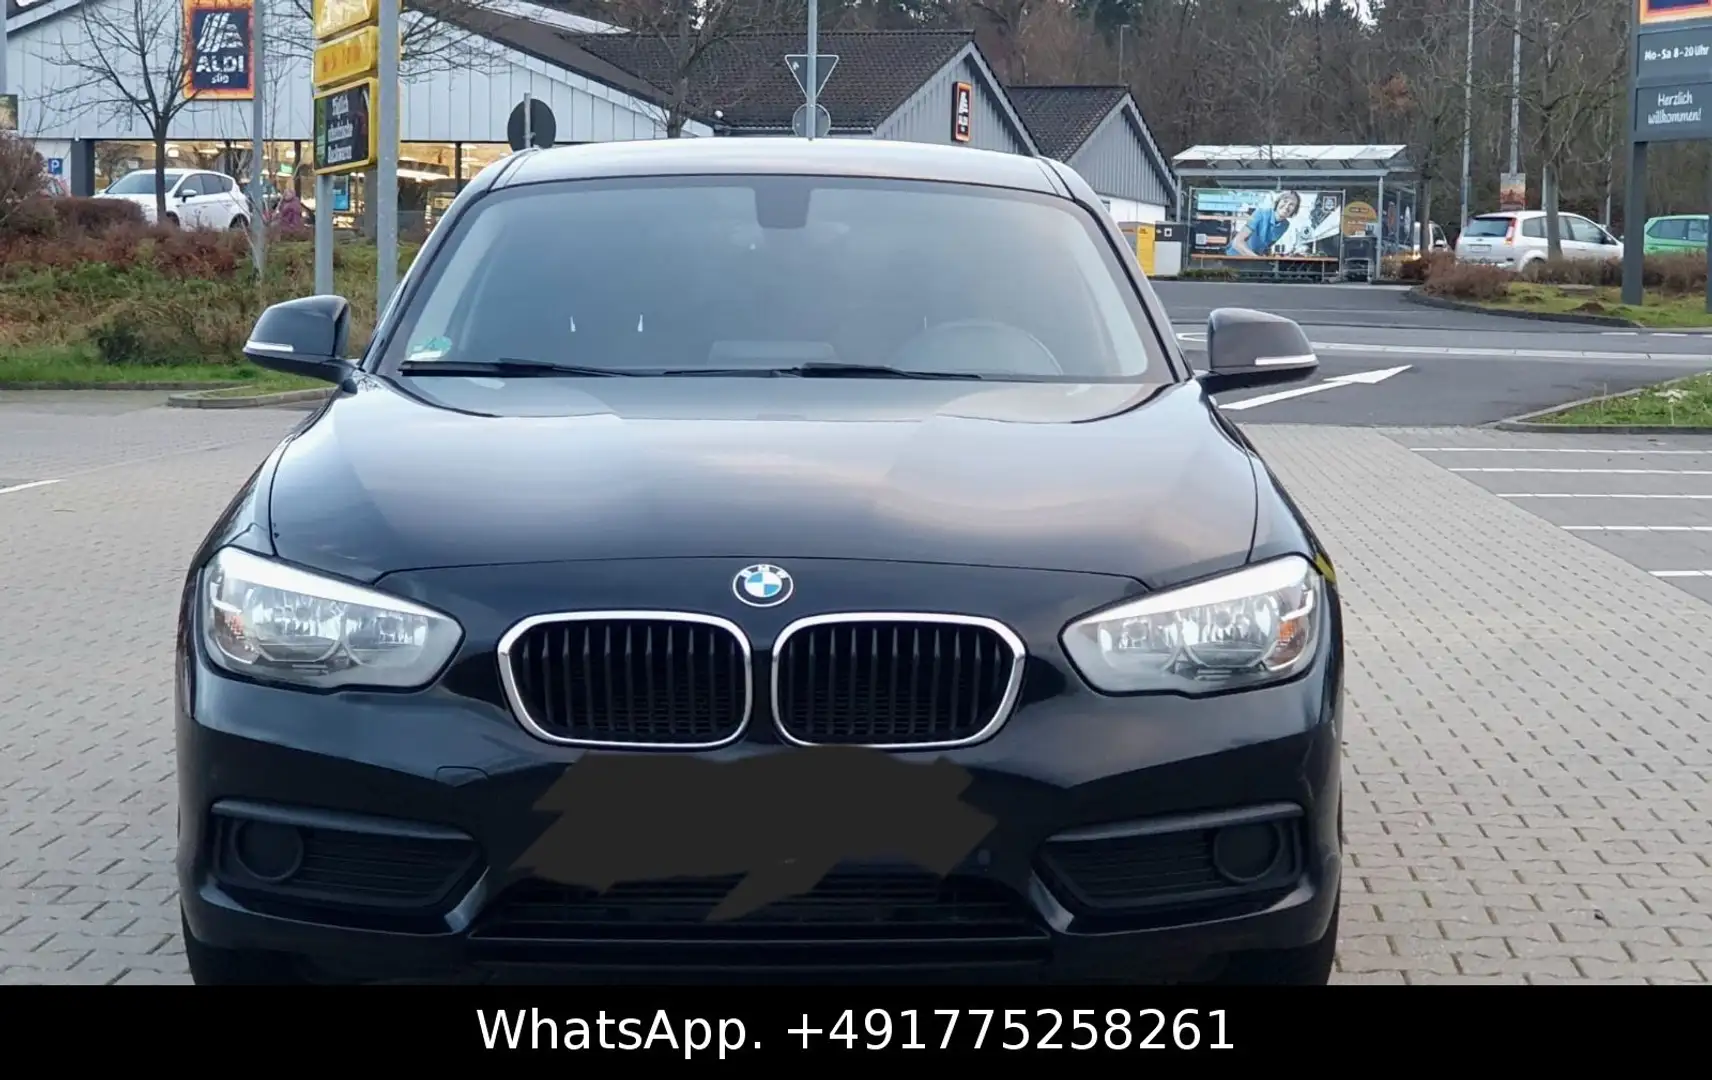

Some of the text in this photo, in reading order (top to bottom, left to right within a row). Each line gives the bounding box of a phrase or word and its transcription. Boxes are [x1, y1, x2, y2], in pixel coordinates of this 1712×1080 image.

[1694, 44, 1710, 56] Uhr
[196, 55, 244, 72] ALDI
[1657, 90, 1693, 107] Herzlich
[1647, 107, 1702, 125] willkommen!
[51, 160, 60, 172] P
[740, 564, 789, 579] BMW
